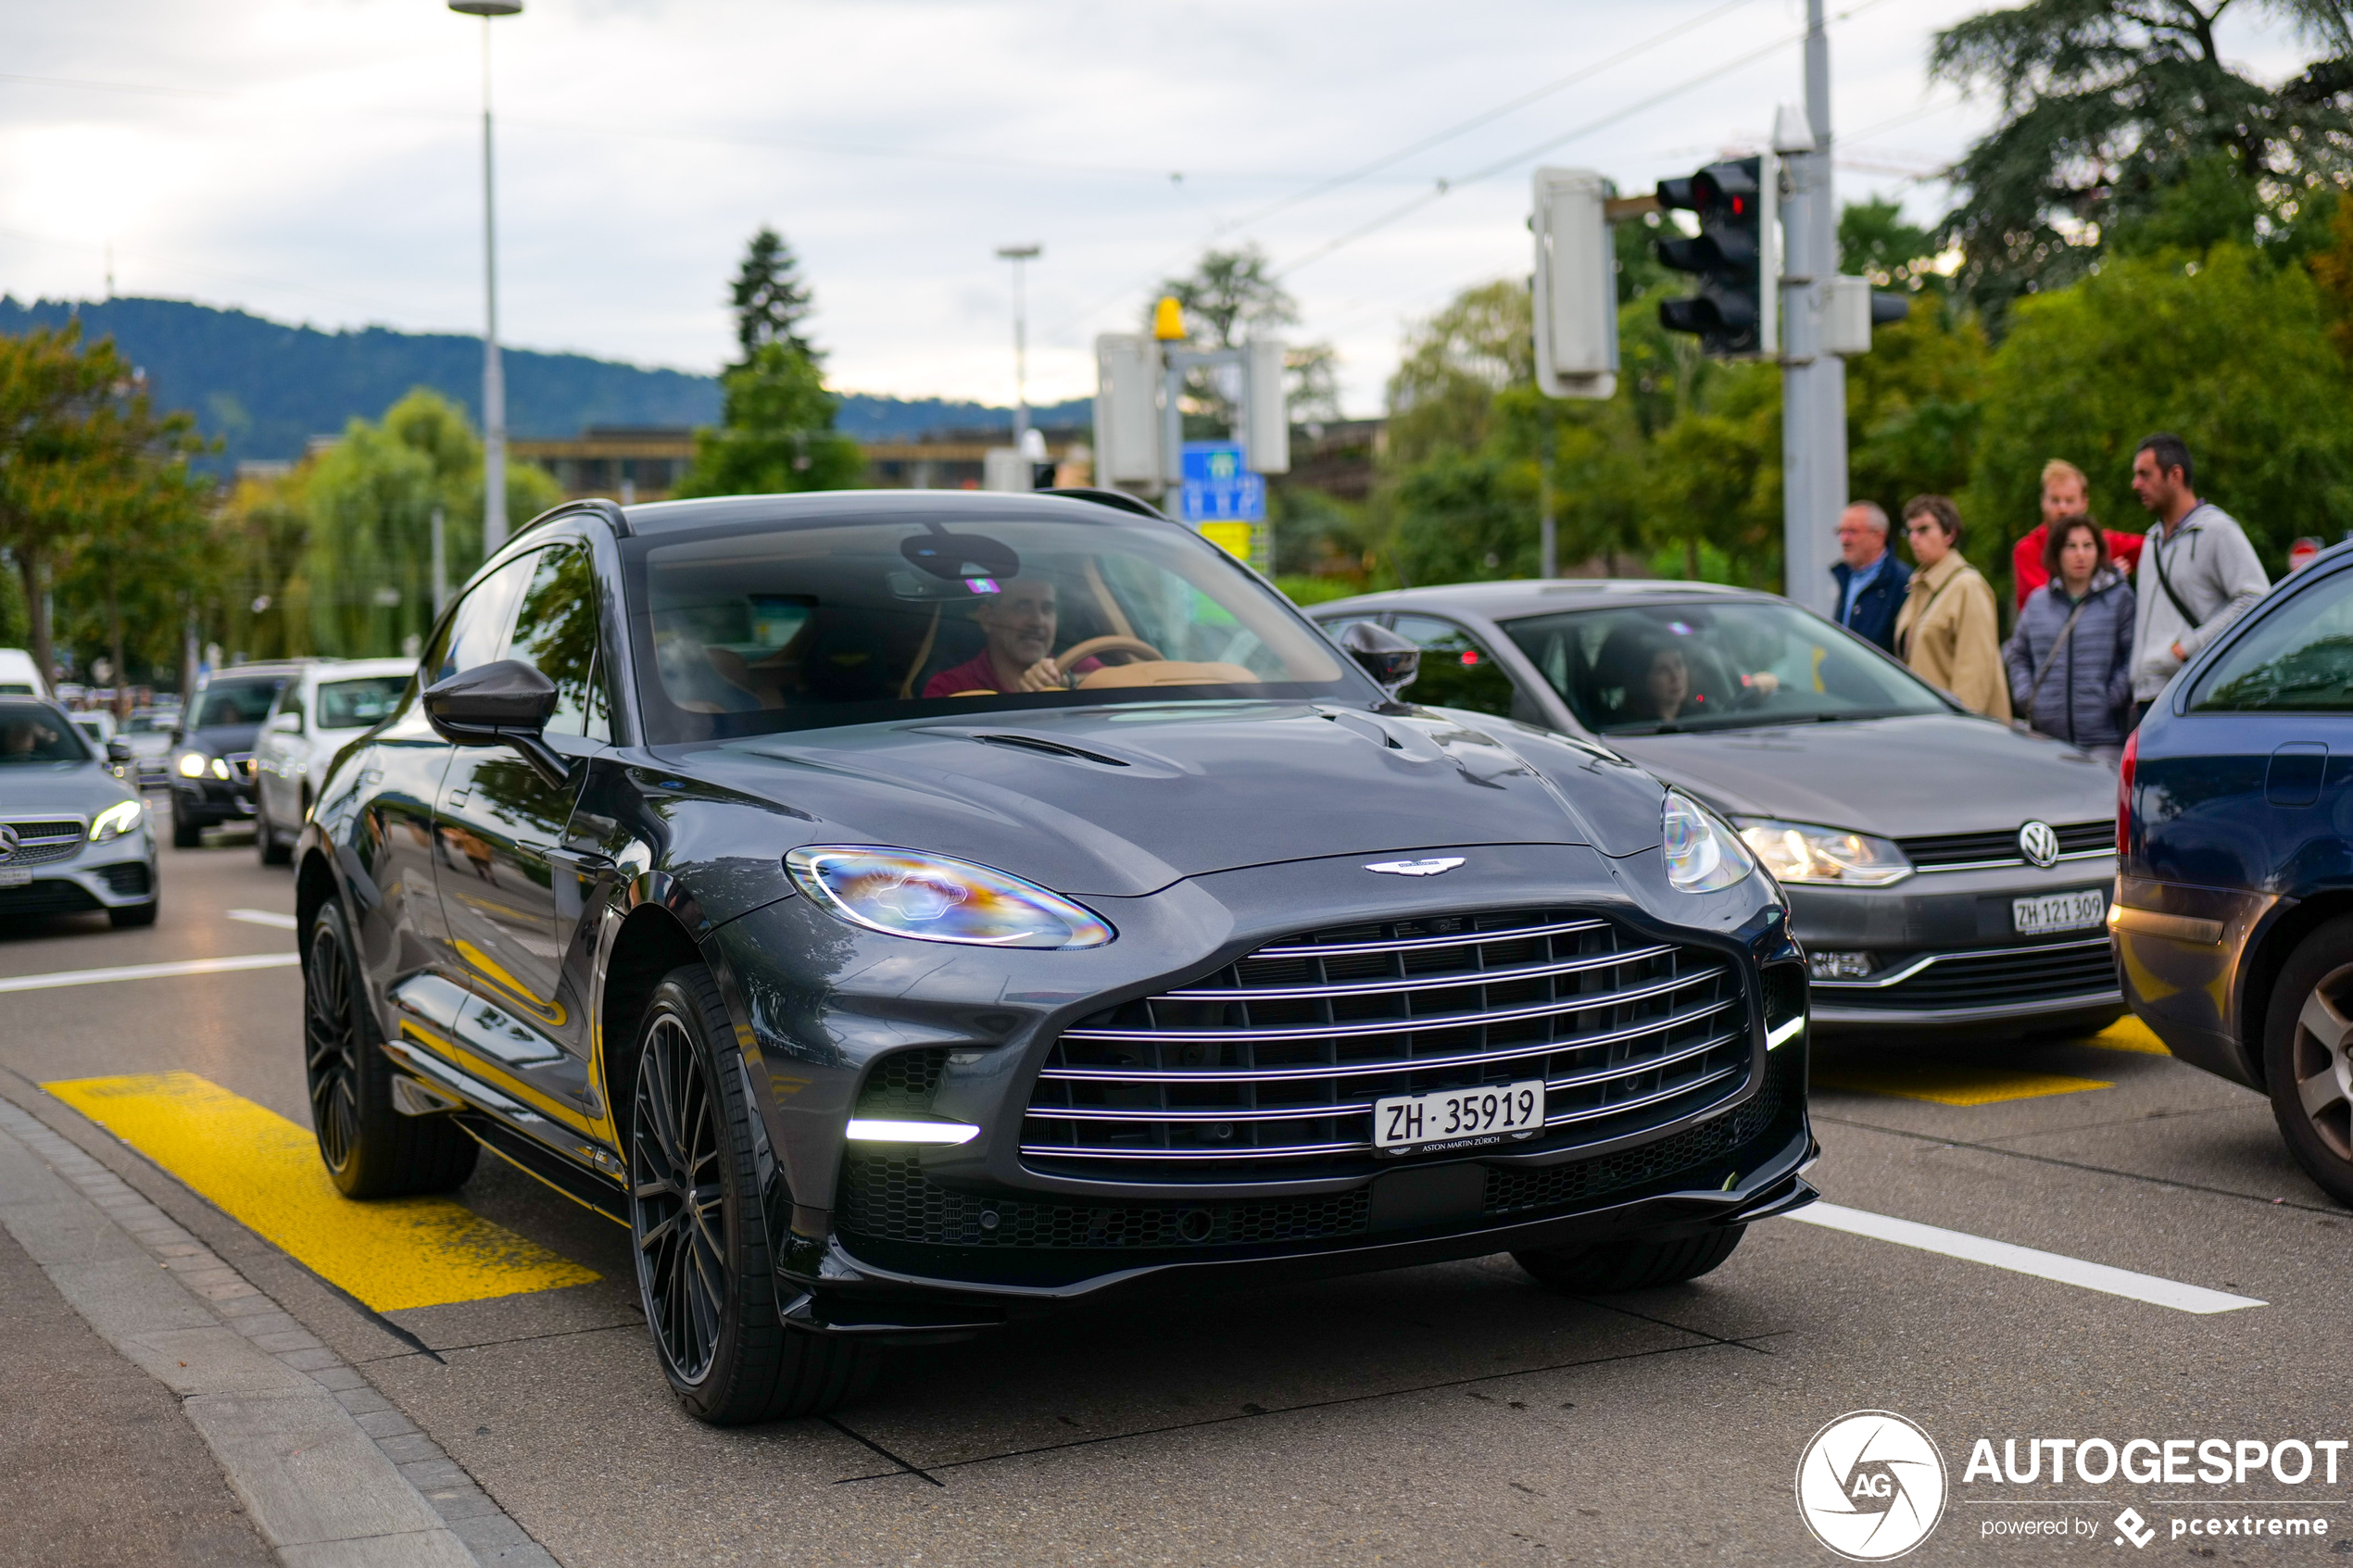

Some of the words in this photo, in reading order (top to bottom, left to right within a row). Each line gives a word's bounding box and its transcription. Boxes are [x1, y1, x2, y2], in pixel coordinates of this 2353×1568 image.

[1422, 1143, 1445, 1152] ASTON
[1447, 1139, 1473, 1149] MARTIN
[1474, 1135, 1500, 1146] ZÜRICH
